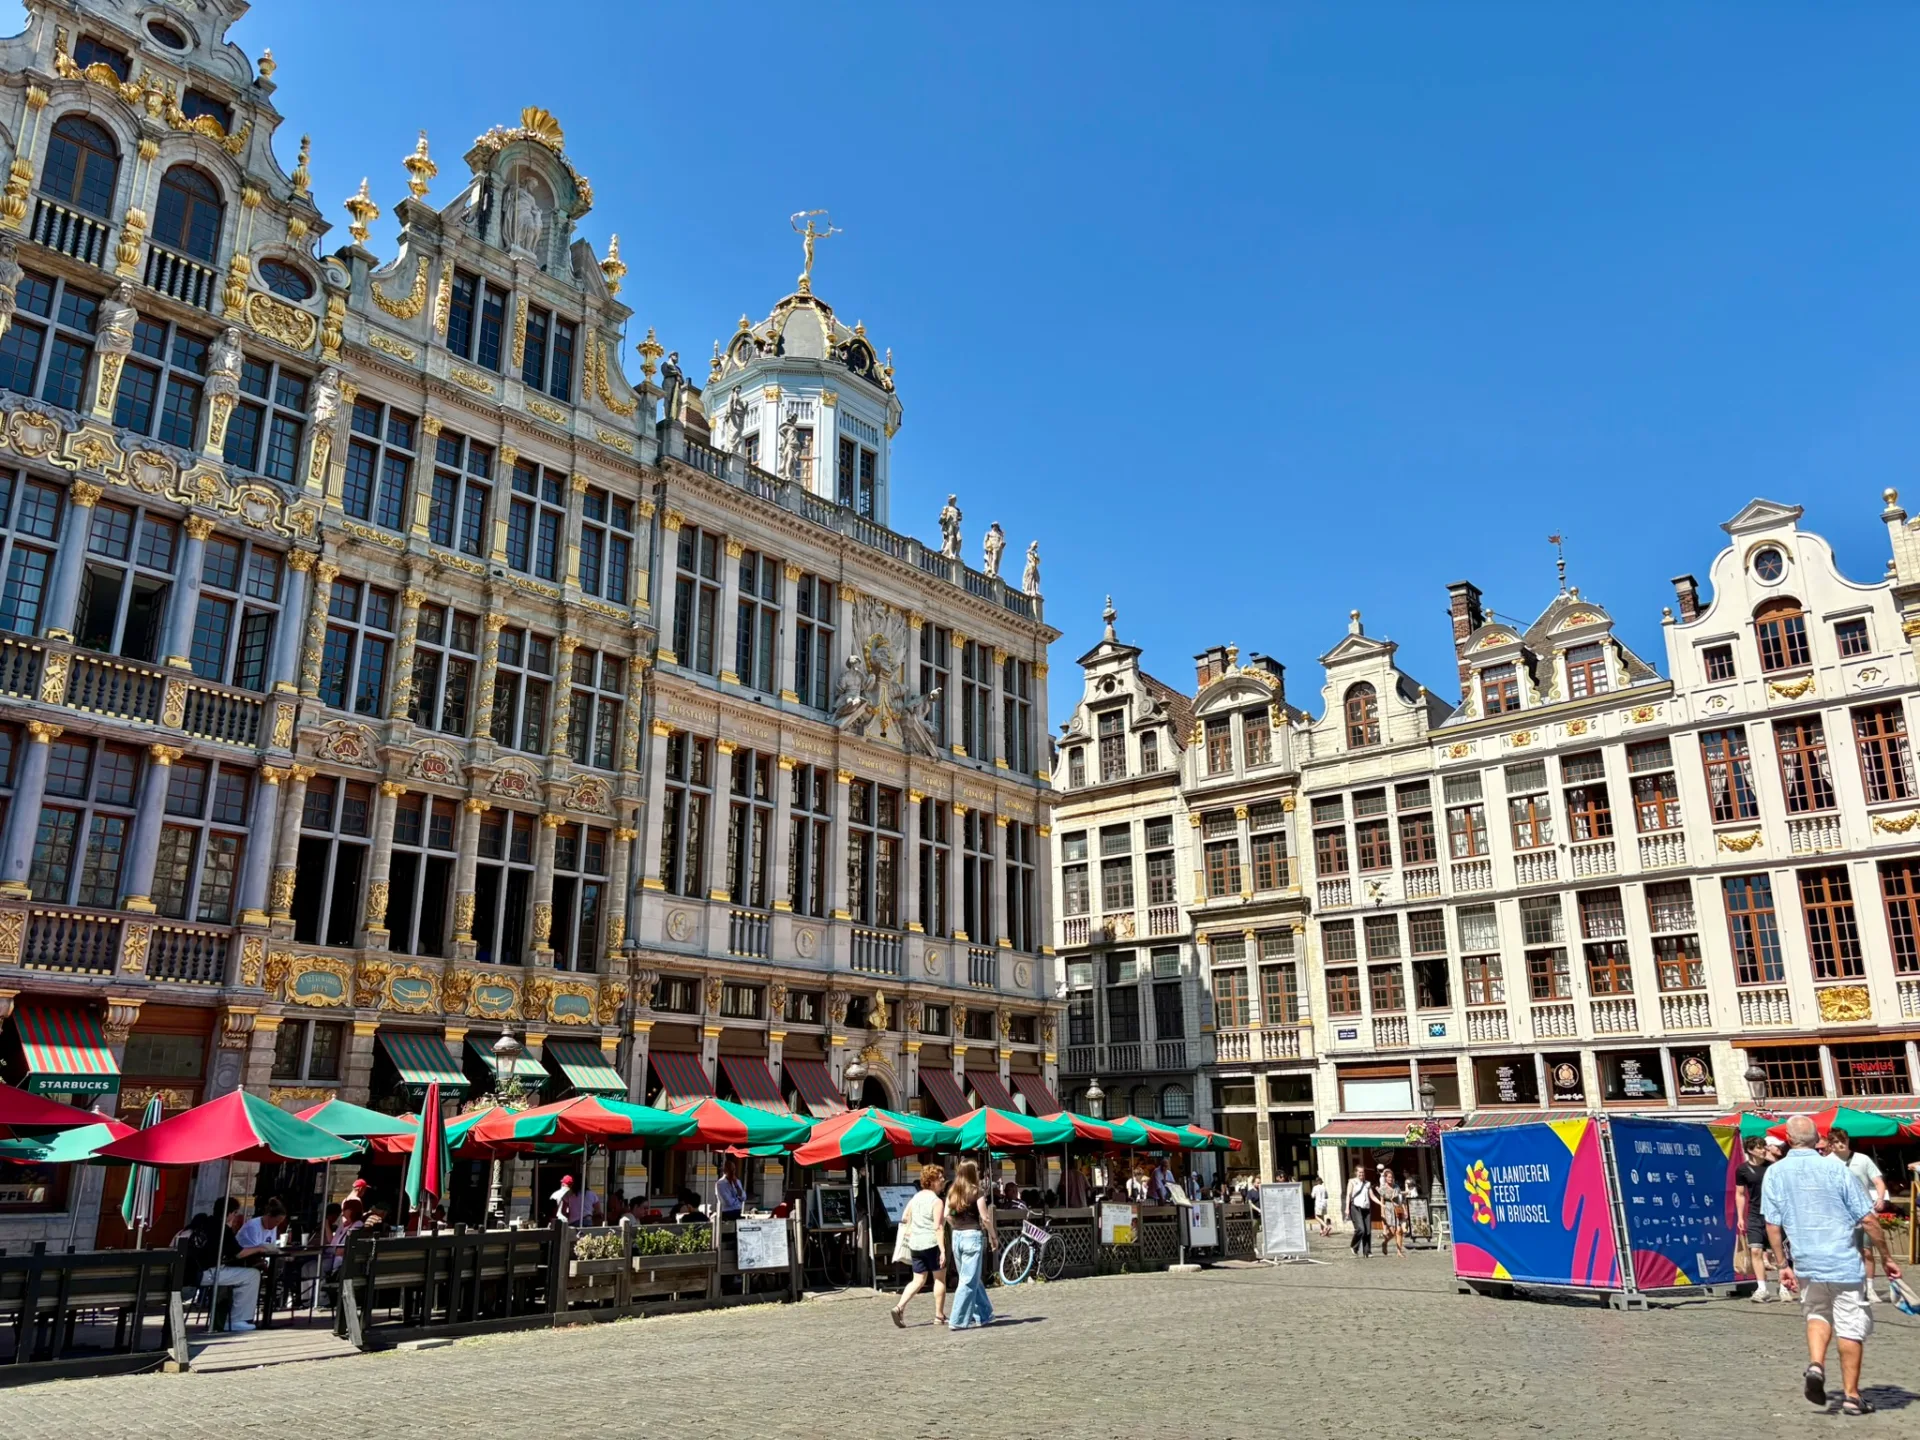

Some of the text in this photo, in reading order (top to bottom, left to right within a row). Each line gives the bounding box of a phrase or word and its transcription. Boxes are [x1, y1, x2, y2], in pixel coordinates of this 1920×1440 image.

[1862, 670, 1877, 682] 97
[427, 761, 443, 772] NO
[39, 1081, 110, 1090] STARBUCKS
[412, 1087, 424, 1096] La
[1316, 1138, 1348, 1146] ARTISAN
[1656, 1142, 1674, 1155] THANK
[1674, 1143, 1685, 1155] YOU
[1687, 1144, 1702, 1156] MERCI
[1490, 1164, 1550, 1184] VLAANDEREN
[1493, 1185, 1520, 1203] FEEST
[1495, 1204, 1551, 1223] IN BRUSSEL
